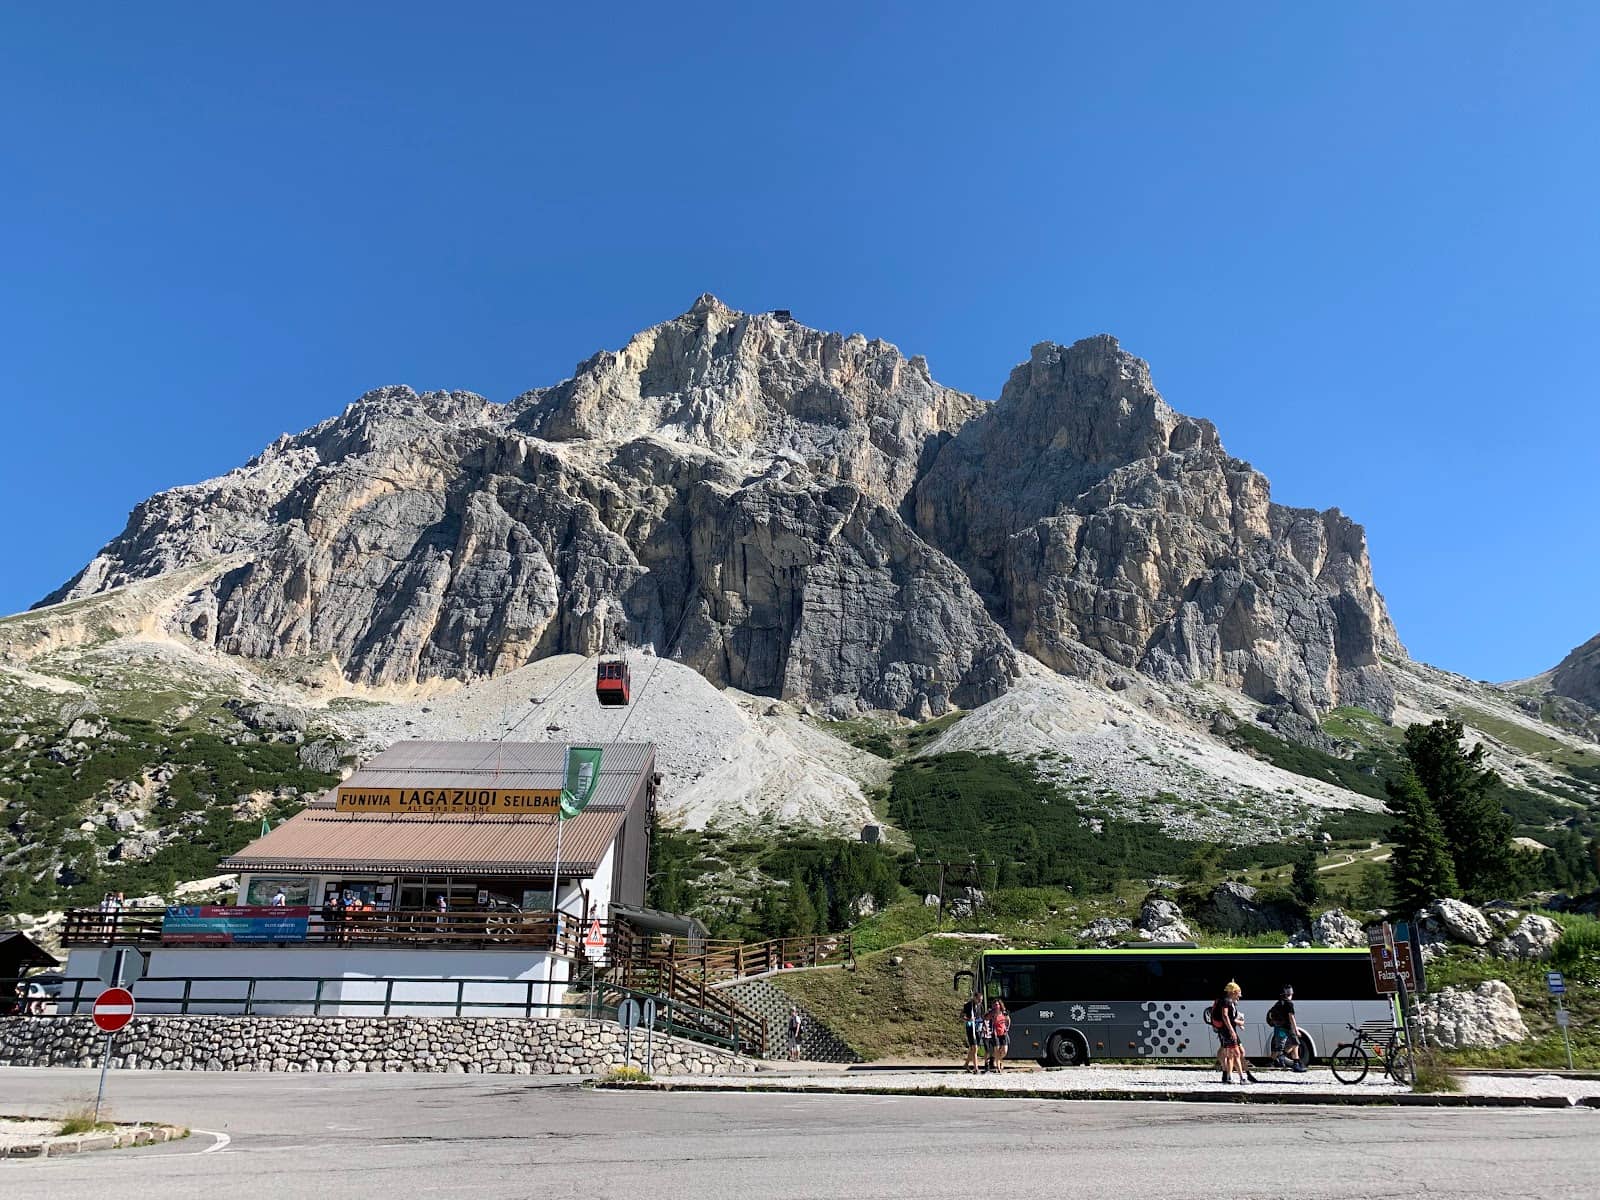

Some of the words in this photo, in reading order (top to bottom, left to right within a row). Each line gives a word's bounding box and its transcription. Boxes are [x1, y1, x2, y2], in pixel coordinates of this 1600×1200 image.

[341, 794, 391, 806] FUNIVIA
[400, 790, 497, 806] LAGAZUOI
[503, 795, 561, 807] SEILBAH
